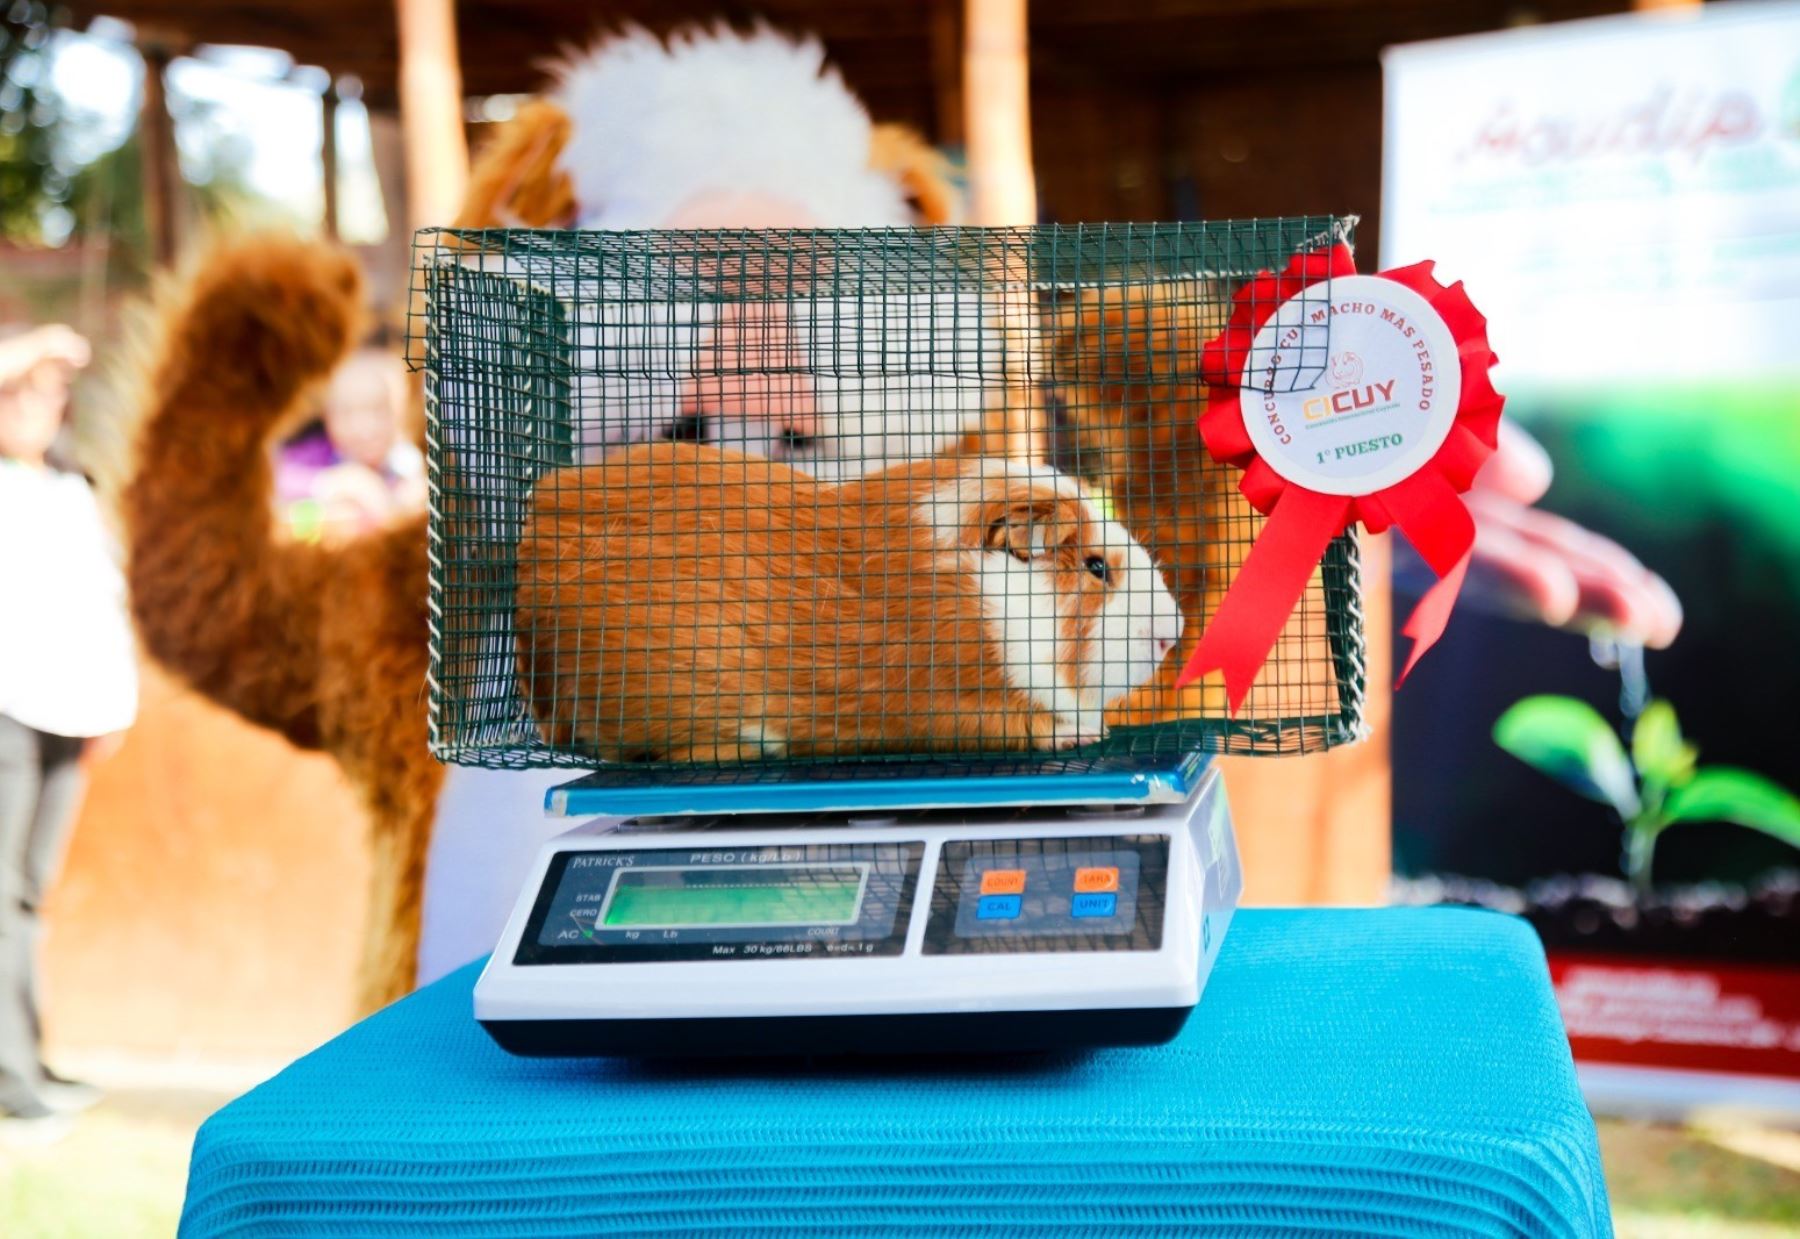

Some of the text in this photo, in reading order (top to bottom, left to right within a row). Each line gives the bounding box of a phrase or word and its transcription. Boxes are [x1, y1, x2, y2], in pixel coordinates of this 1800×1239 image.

[1311, 302, 1376, 324] MACHO
[1380, 306, 1416, 338] MAS
[1413, 340, 1434, 411] PESADO
[1303, 379, 1395, 420] CICUY
[1335, 433, 1404, 460] PUESTO
[573, 856, 635, 869] PATRICK'S
[690, 853, 736, 863] PESO
[576, 894, 602, 903] STAB
[987, 902, 1012, 912] CAL
[1080, 899, 1109, 909] UNIT
[570, 908, 598, 918] CERO
[558, 930, 579, 939] AC
[625, 931, 640, 940] kg
[712, 945, 736, 954] Max
